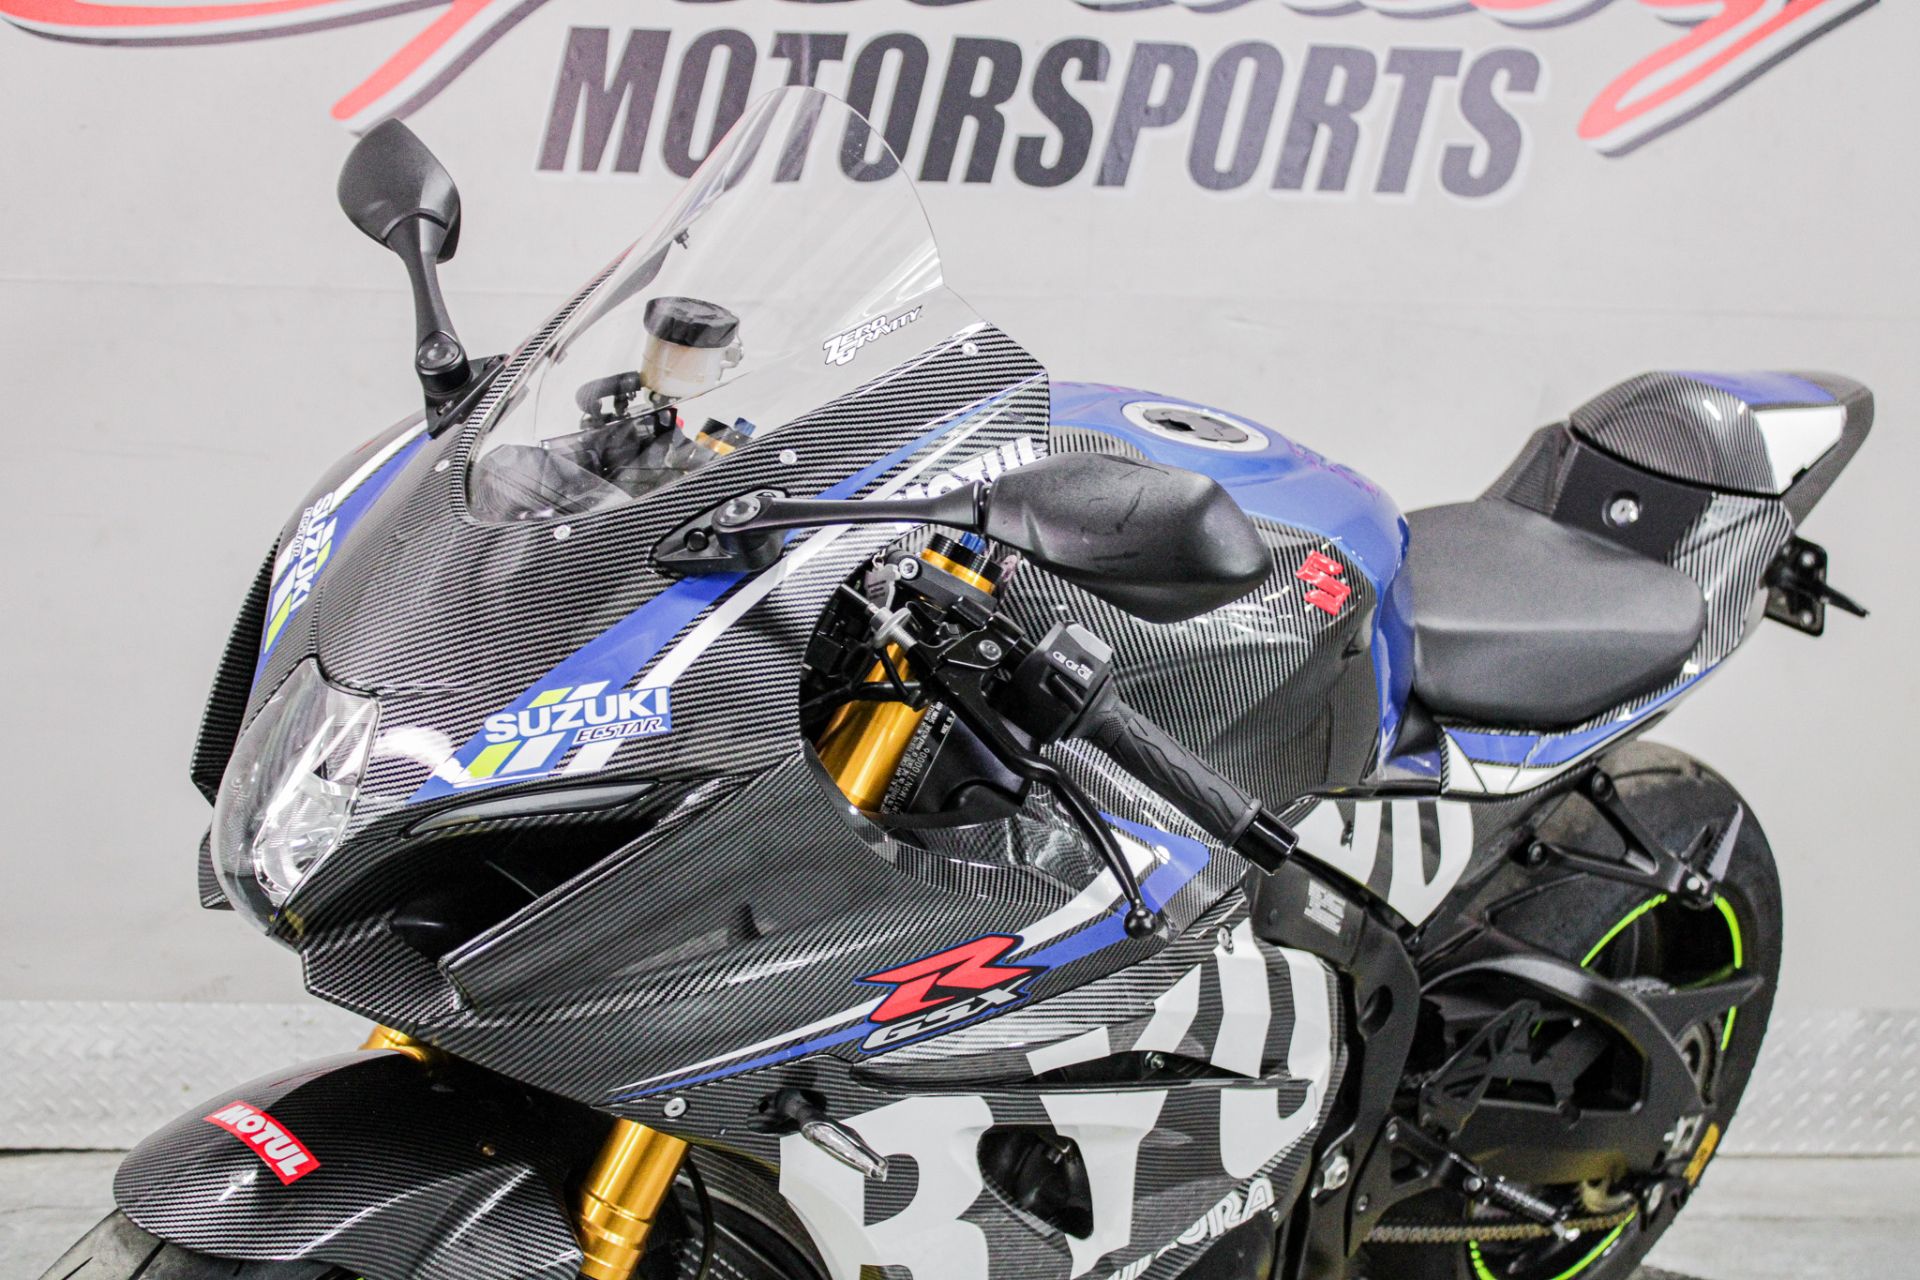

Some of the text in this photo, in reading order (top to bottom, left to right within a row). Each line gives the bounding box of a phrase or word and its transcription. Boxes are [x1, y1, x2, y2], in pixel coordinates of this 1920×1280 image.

[537, 27, 1541, 197] MOTORSPORTS
[823, 315, 886, 364] ZERO
[836, 305, 922, 366] GRAVITY
[290, 492, 336, 612] SUZUKI
[484, 687, 668, 743] SUZUKI
[573, 717, 664, 745] ECSTAR
[862, 976, 1032, 1050] GSX
[211, 1104, 310, 1177] MOTUL
